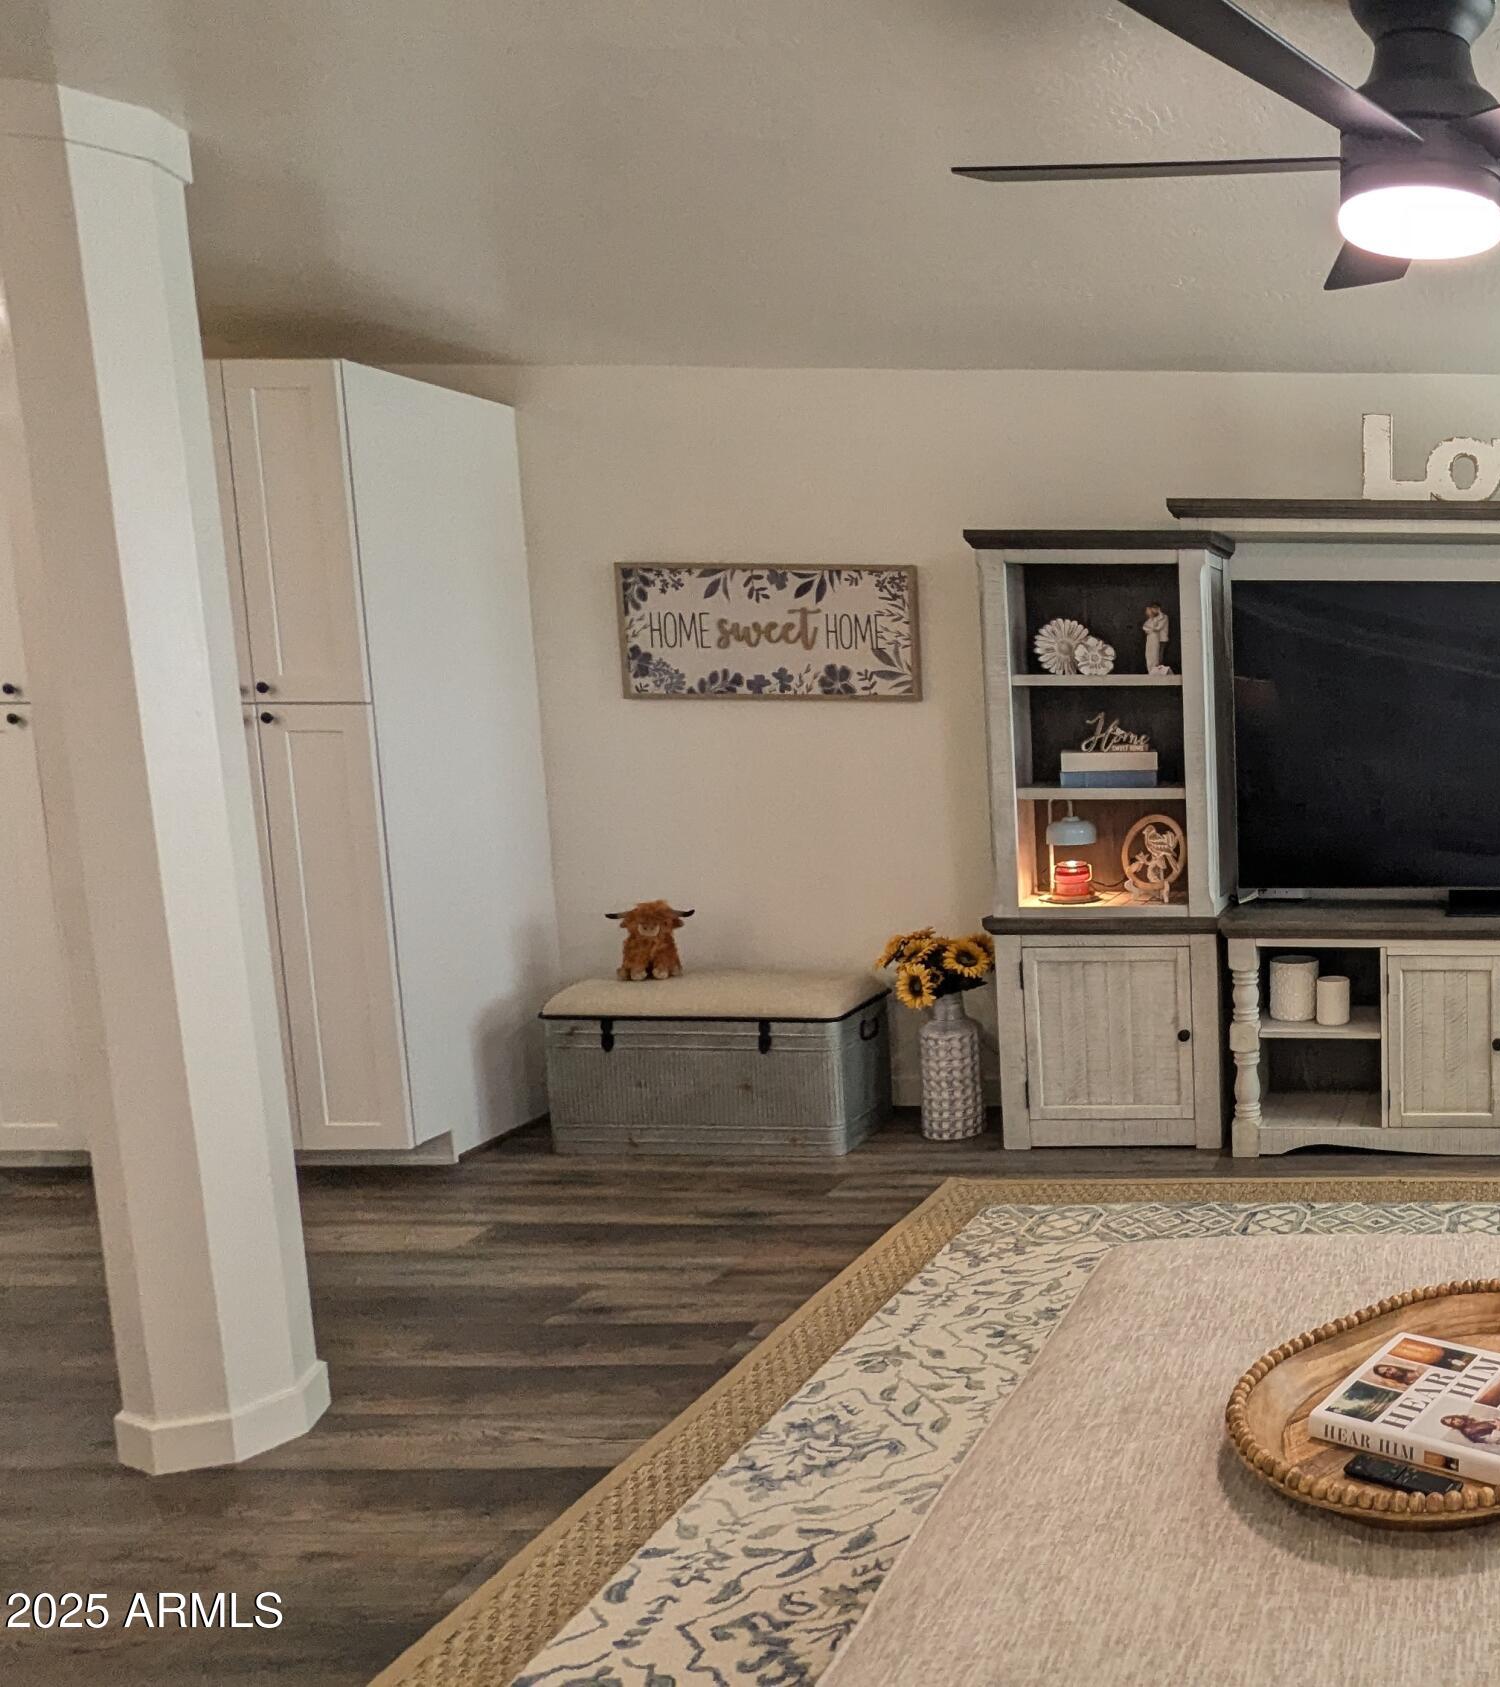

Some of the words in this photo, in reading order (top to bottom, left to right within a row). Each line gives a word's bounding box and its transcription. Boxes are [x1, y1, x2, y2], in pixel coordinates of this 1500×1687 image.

[650, 611, 711, 648] HOME
[716, 606, 822, 650] sweet
[825, 613, 887, 650] HOME
[1081, 711, 1150, 752] Home
[1379, 1371, 1457, 1431] HEAR
[1323, 1423, 1371, 1450] HEAR
[1378, 1438, 1415, 1461] HIM
